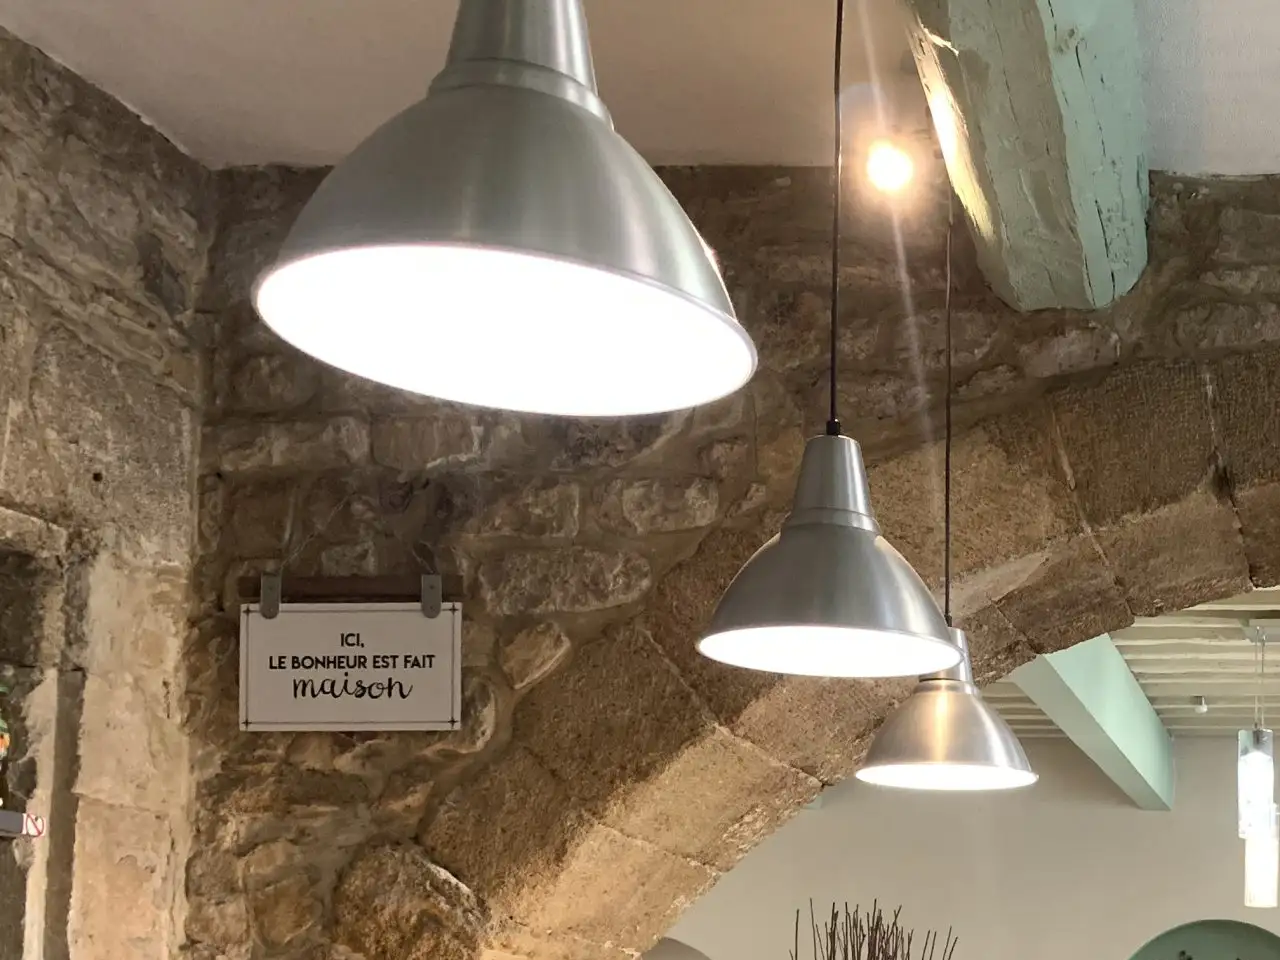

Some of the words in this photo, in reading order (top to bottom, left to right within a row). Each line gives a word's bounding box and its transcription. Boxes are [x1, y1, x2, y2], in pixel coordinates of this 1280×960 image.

[340, 633, 365, 648] ICI,
[269, 655, 287, 670] LE
[291, 655, 368, 670] BONHEUR
[372, 655, 399, 669] EST
[403, 654, 436, 669] FAIT
[293, 672, 414, 699] maison
